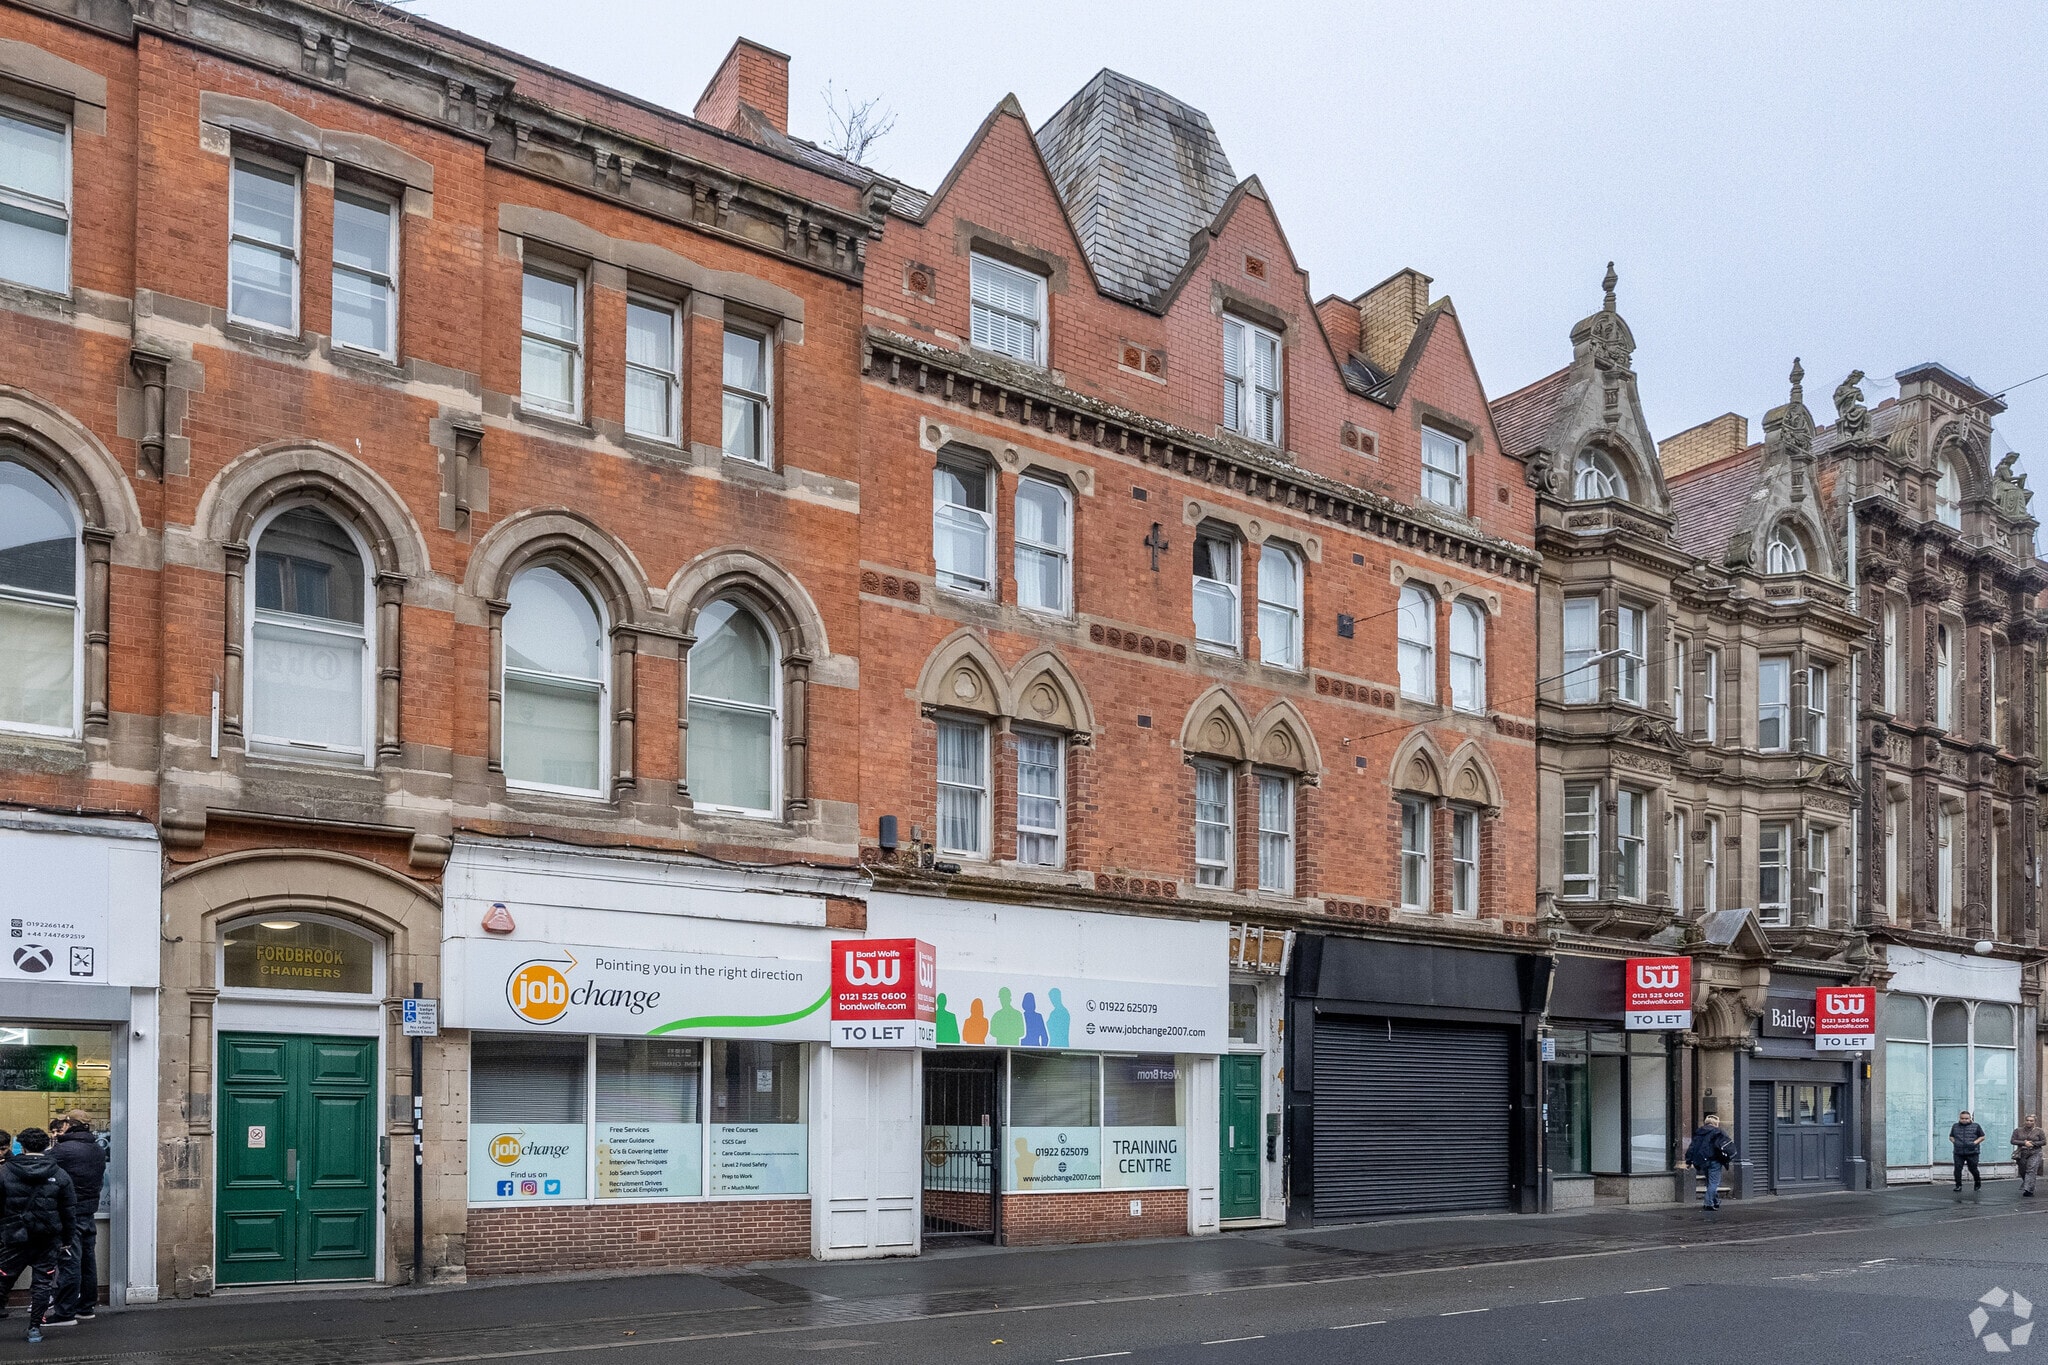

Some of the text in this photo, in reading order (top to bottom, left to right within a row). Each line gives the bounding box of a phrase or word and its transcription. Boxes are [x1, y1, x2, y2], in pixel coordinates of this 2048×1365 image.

[26, 921, 74, 929] 01922661474
[256, 945, 344, 965] FORDBROOK
[260, 965, 341, 978] CHAMBERS
[595, 958, 803, 981] Pointing you in the right direction
[518, 974, 661, 1015] job change
[881, 992, 907, 1000] 0600
[839, 1002, 906, 1011] bondwolfe.com
[1099, 1001, 1158, 1014] 01922 625079
[1634, 1015, 1682, 1024] TO LET
[1772, 1008, 1816, 1034] Baileys
[841, 1026, 905, 1040] TO LET
[1099, 1024, 1206, 1037] www.jobchange2007.com
[1823, 1038, 1867, 1046] TO LET
[494, 1139, 570, 1159] job change
[1035, 1147, 1089, 1157] 01922 625079
[1112, 1140, 1177, 1155] TRAINING
[1119, 1158, 1172, 1173] CENTRE
[1023, 1173, 1101, 1182] www.jobchange2007.com
